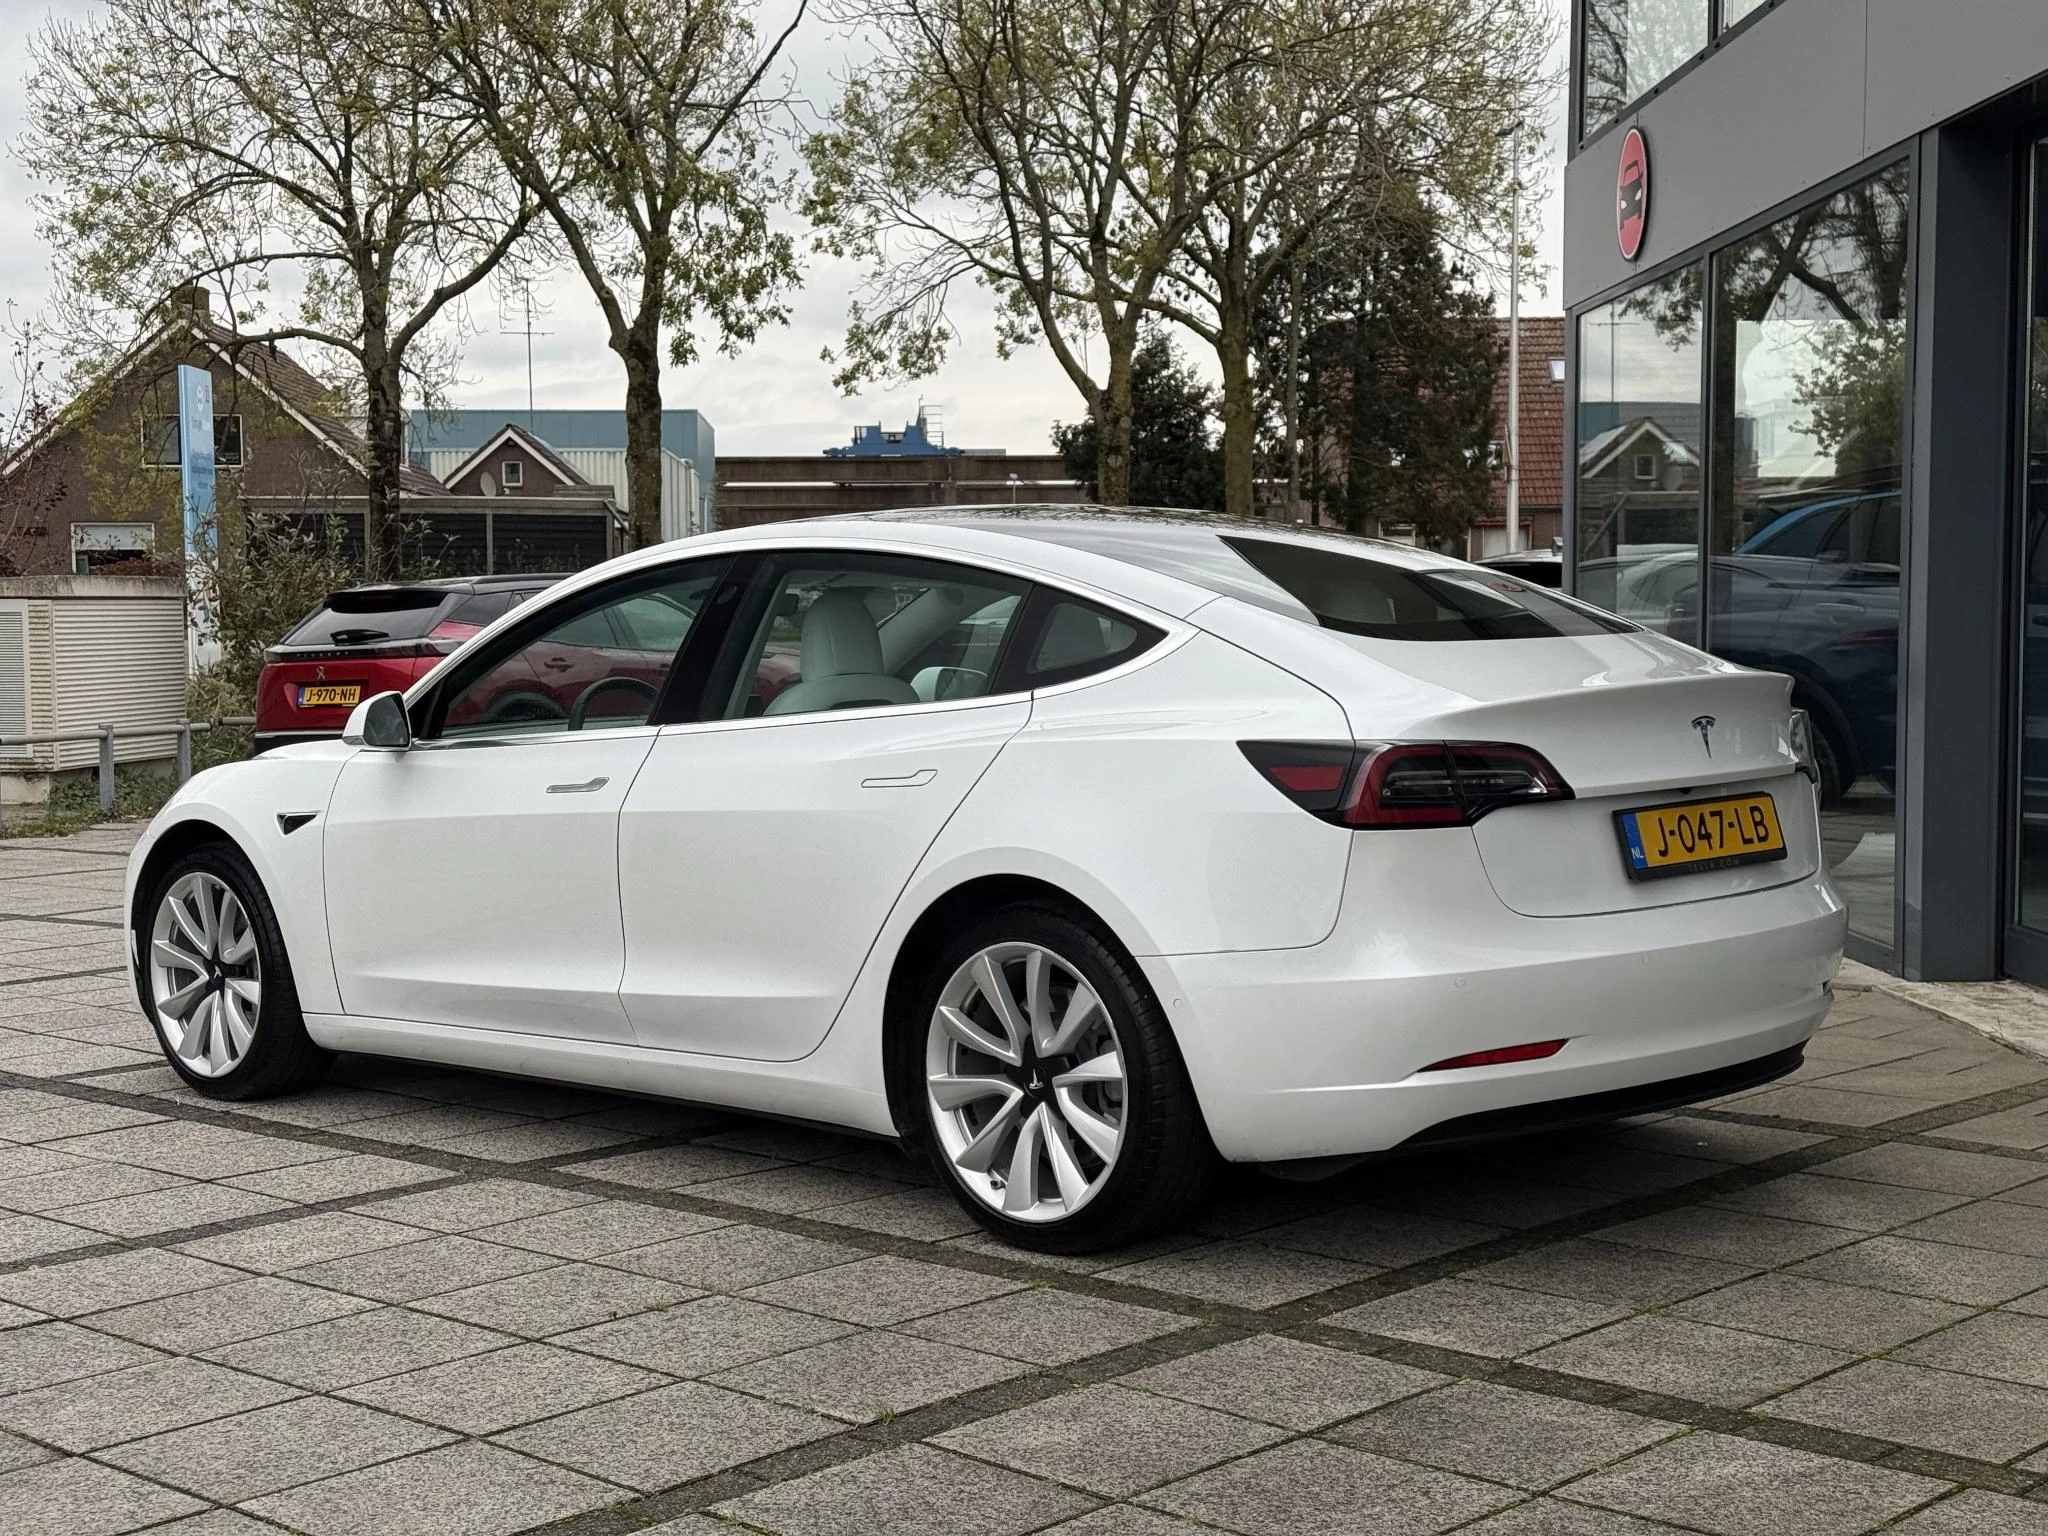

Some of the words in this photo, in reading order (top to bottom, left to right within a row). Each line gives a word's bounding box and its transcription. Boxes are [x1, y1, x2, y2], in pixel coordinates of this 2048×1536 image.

[306, 688, 357, 702] J-970-NH
[1658, 805, 1770, 857] J-047-LB
[1631, 847, 1645, 860] NL
